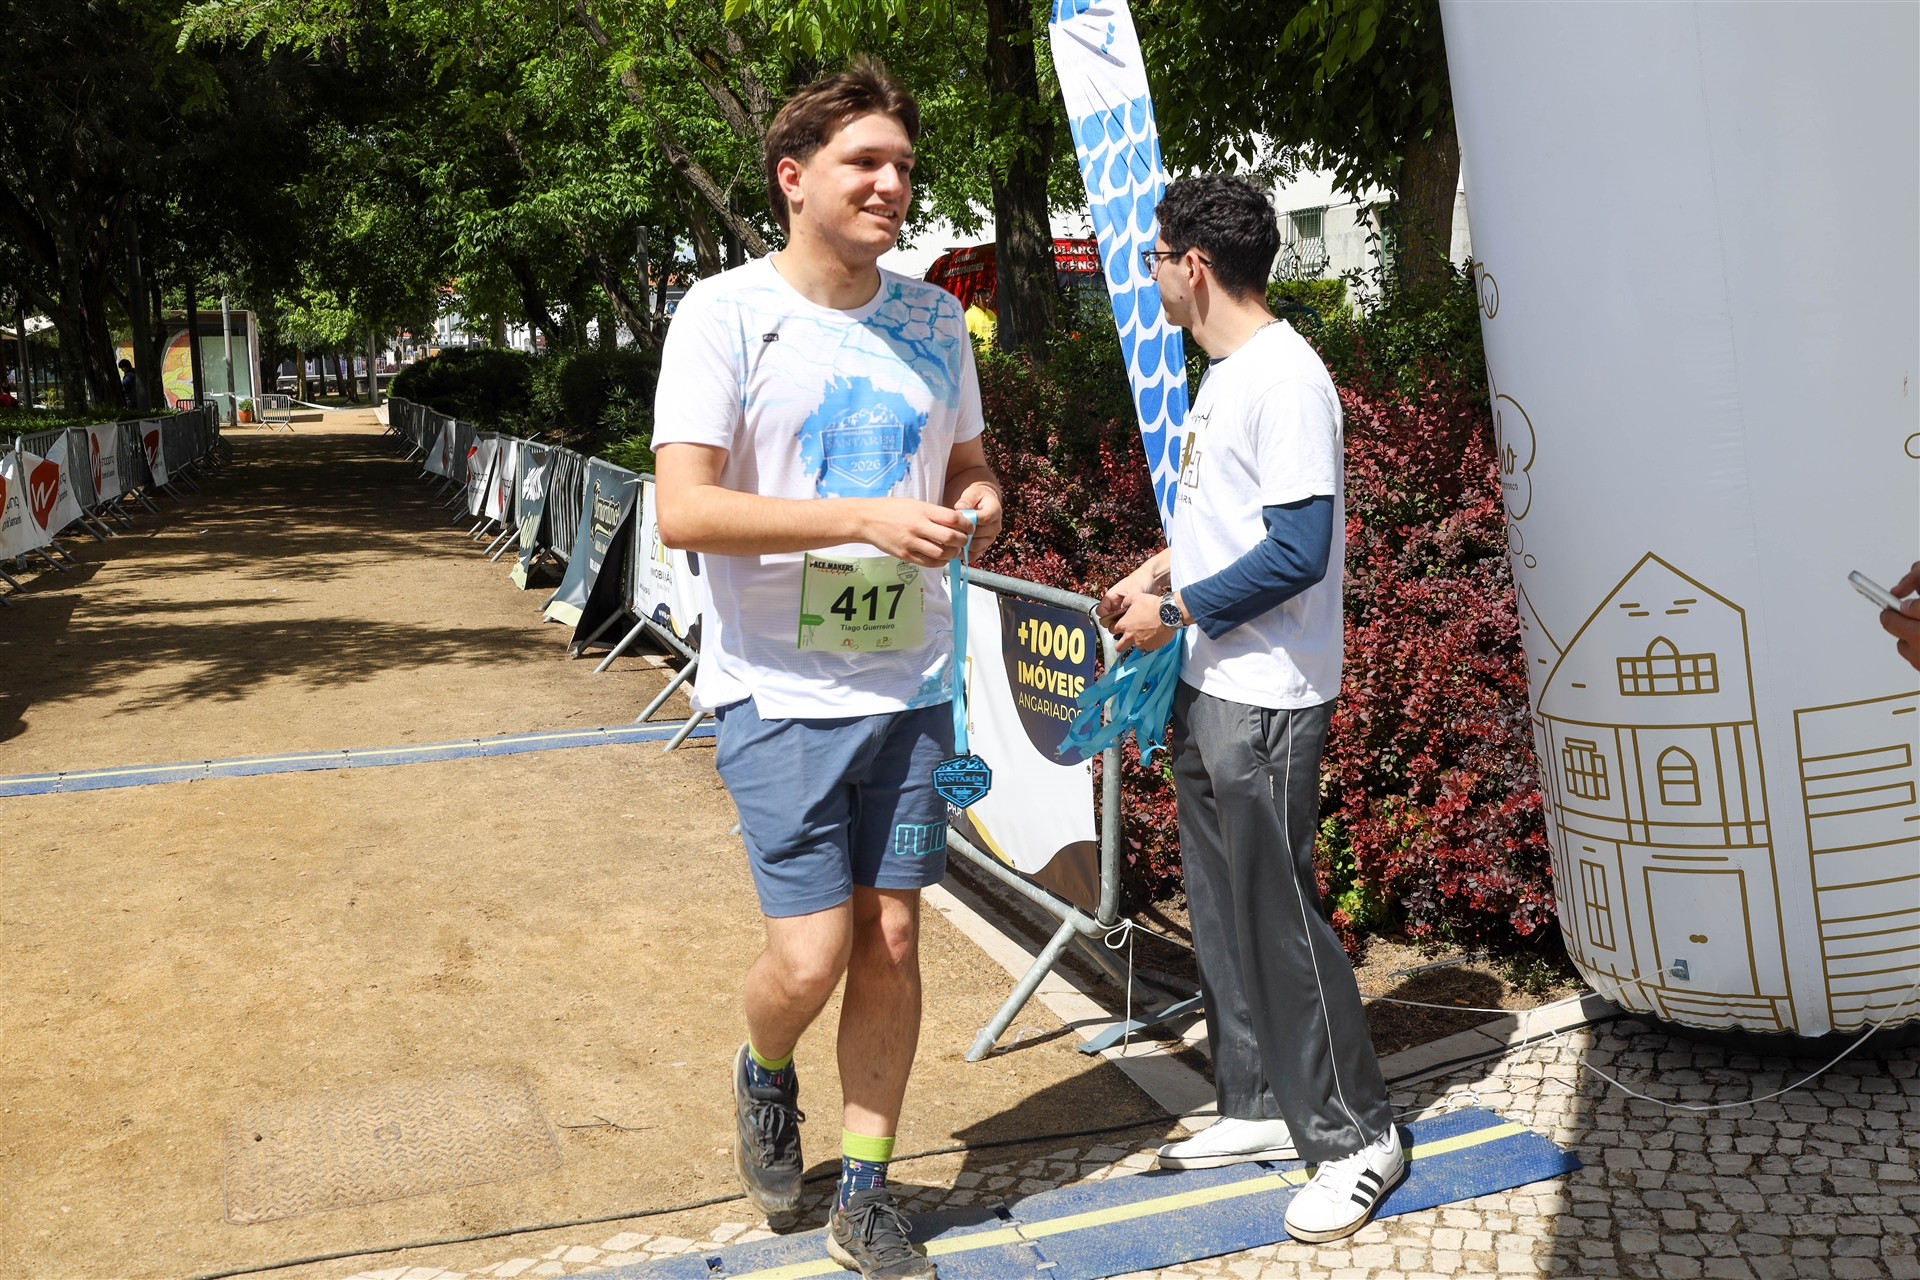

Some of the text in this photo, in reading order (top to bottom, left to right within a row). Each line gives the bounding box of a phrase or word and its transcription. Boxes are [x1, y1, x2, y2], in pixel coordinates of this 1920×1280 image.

[826, 432, 897, 449] SANTARÉM
[850, 459, 881, 472] 2026
[830, 583, 905, 622] 417
[840, 623, 895, 633] Tiago Guerreiro
[1017, 618, 1086, 665] +1000
[1017, 660, 1086, 699] IMÓVEIS
[937, 774, 985, 783] SANTARÉM
